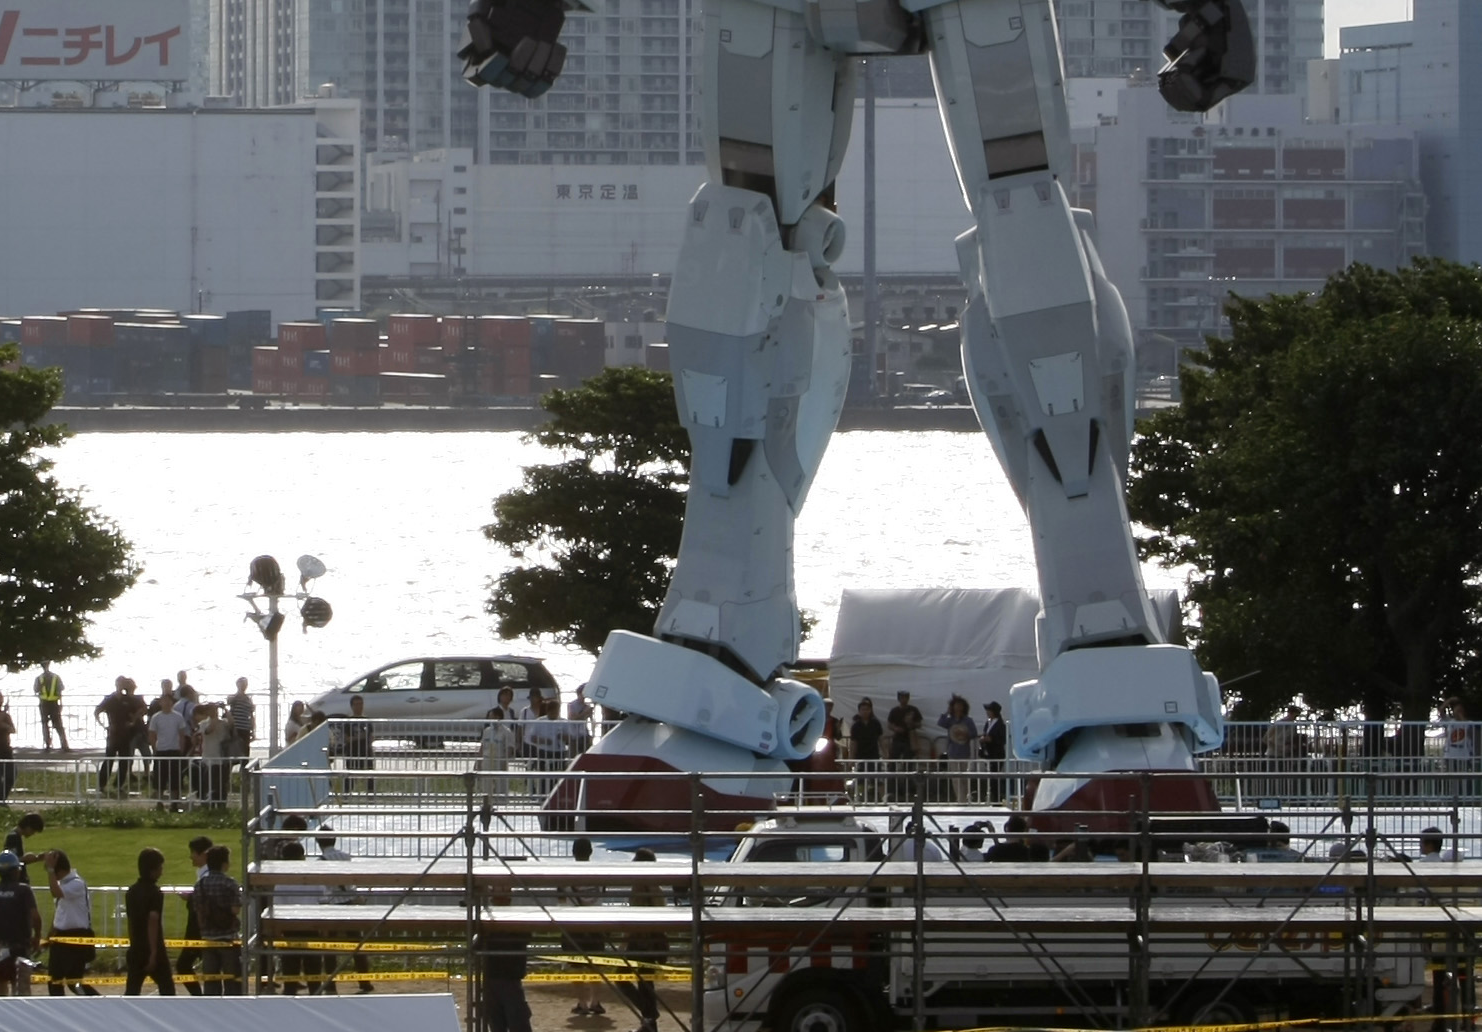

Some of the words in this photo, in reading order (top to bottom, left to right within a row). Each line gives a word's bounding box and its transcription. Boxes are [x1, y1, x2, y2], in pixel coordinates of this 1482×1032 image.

[20, 25, 181, 66] ニチレイ
[555, 184, 639, 200] 東京定温
